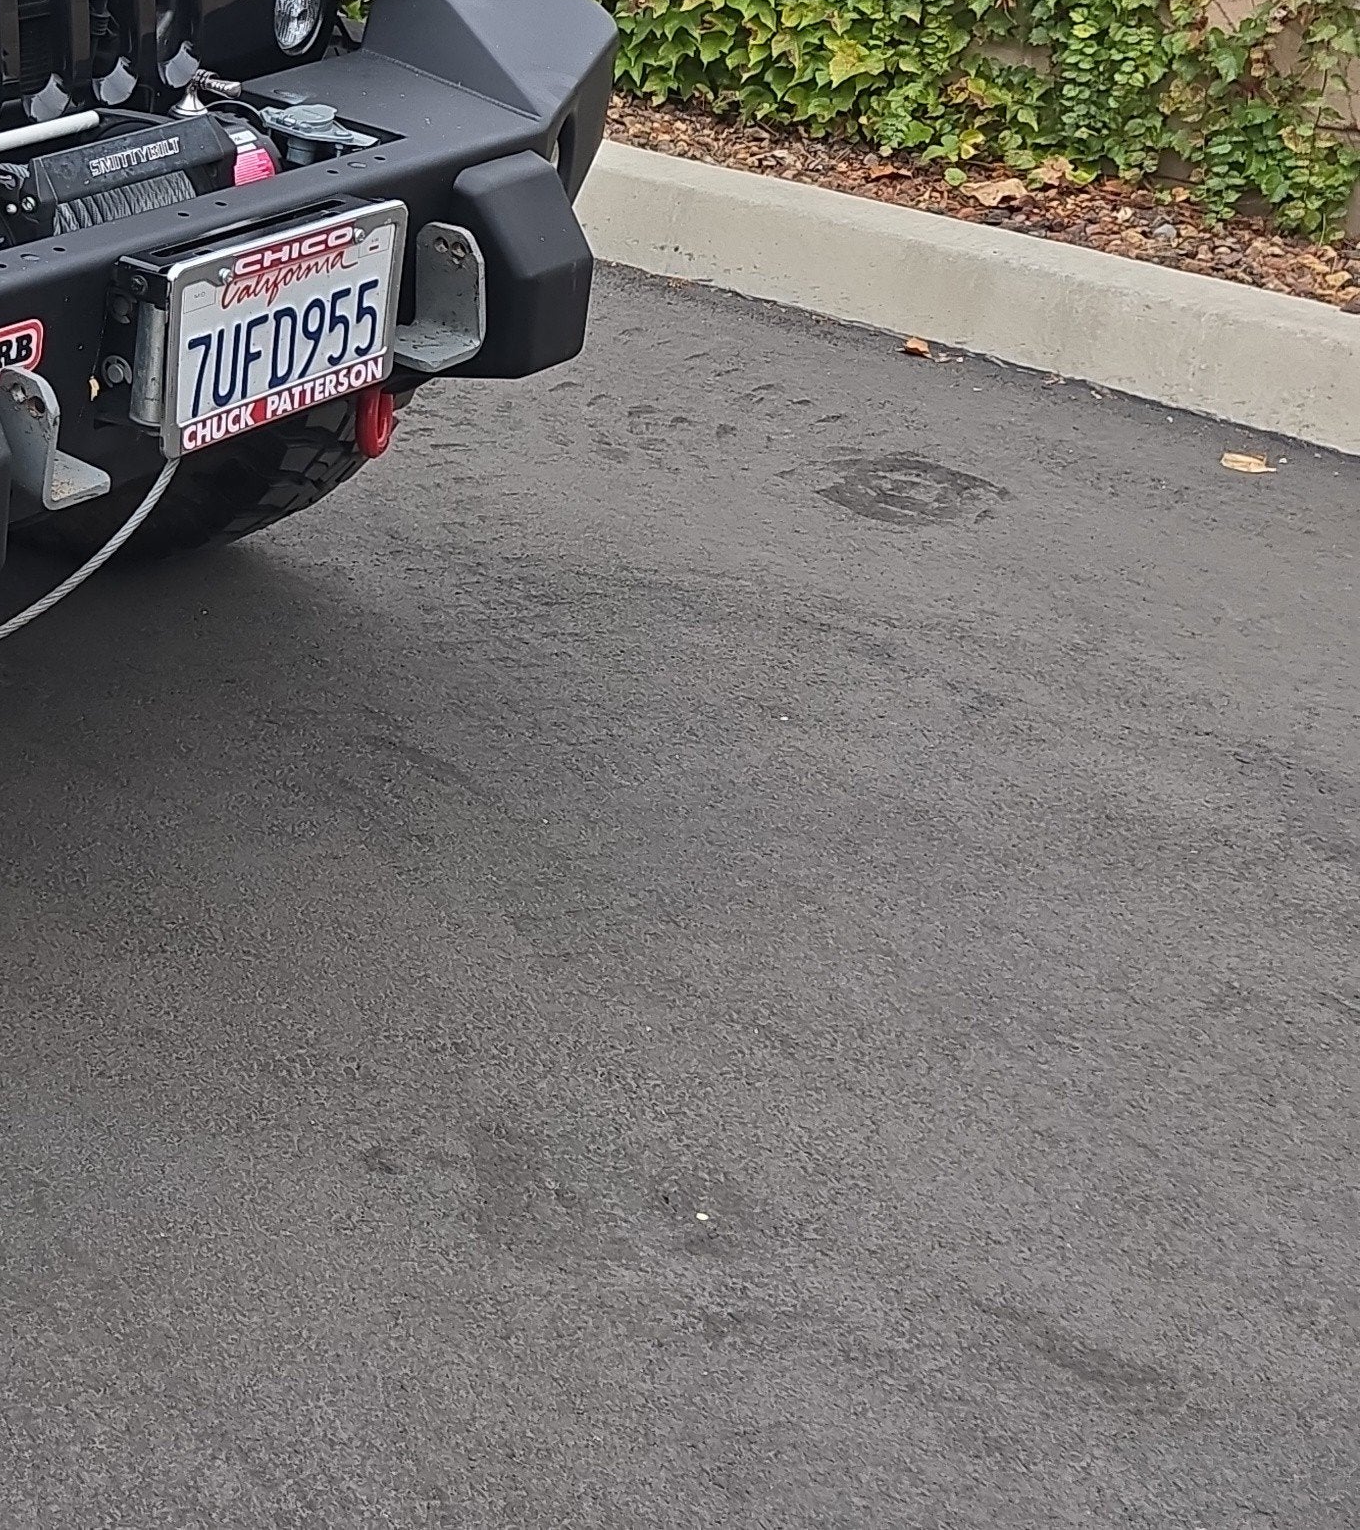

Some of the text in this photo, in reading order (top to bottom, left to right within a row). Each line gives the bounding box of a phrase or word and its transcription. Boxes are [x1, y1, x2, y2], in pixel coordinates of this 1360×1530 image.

[89, 137, 180, 178] SMITTYBILT
[221, 250, 358, 310] California
[235, 225, 354, 276] CHICO
[188, 278, 379, 419] 7UFD955
[182, 356, 384, 450] CHUCK PATTERSON
